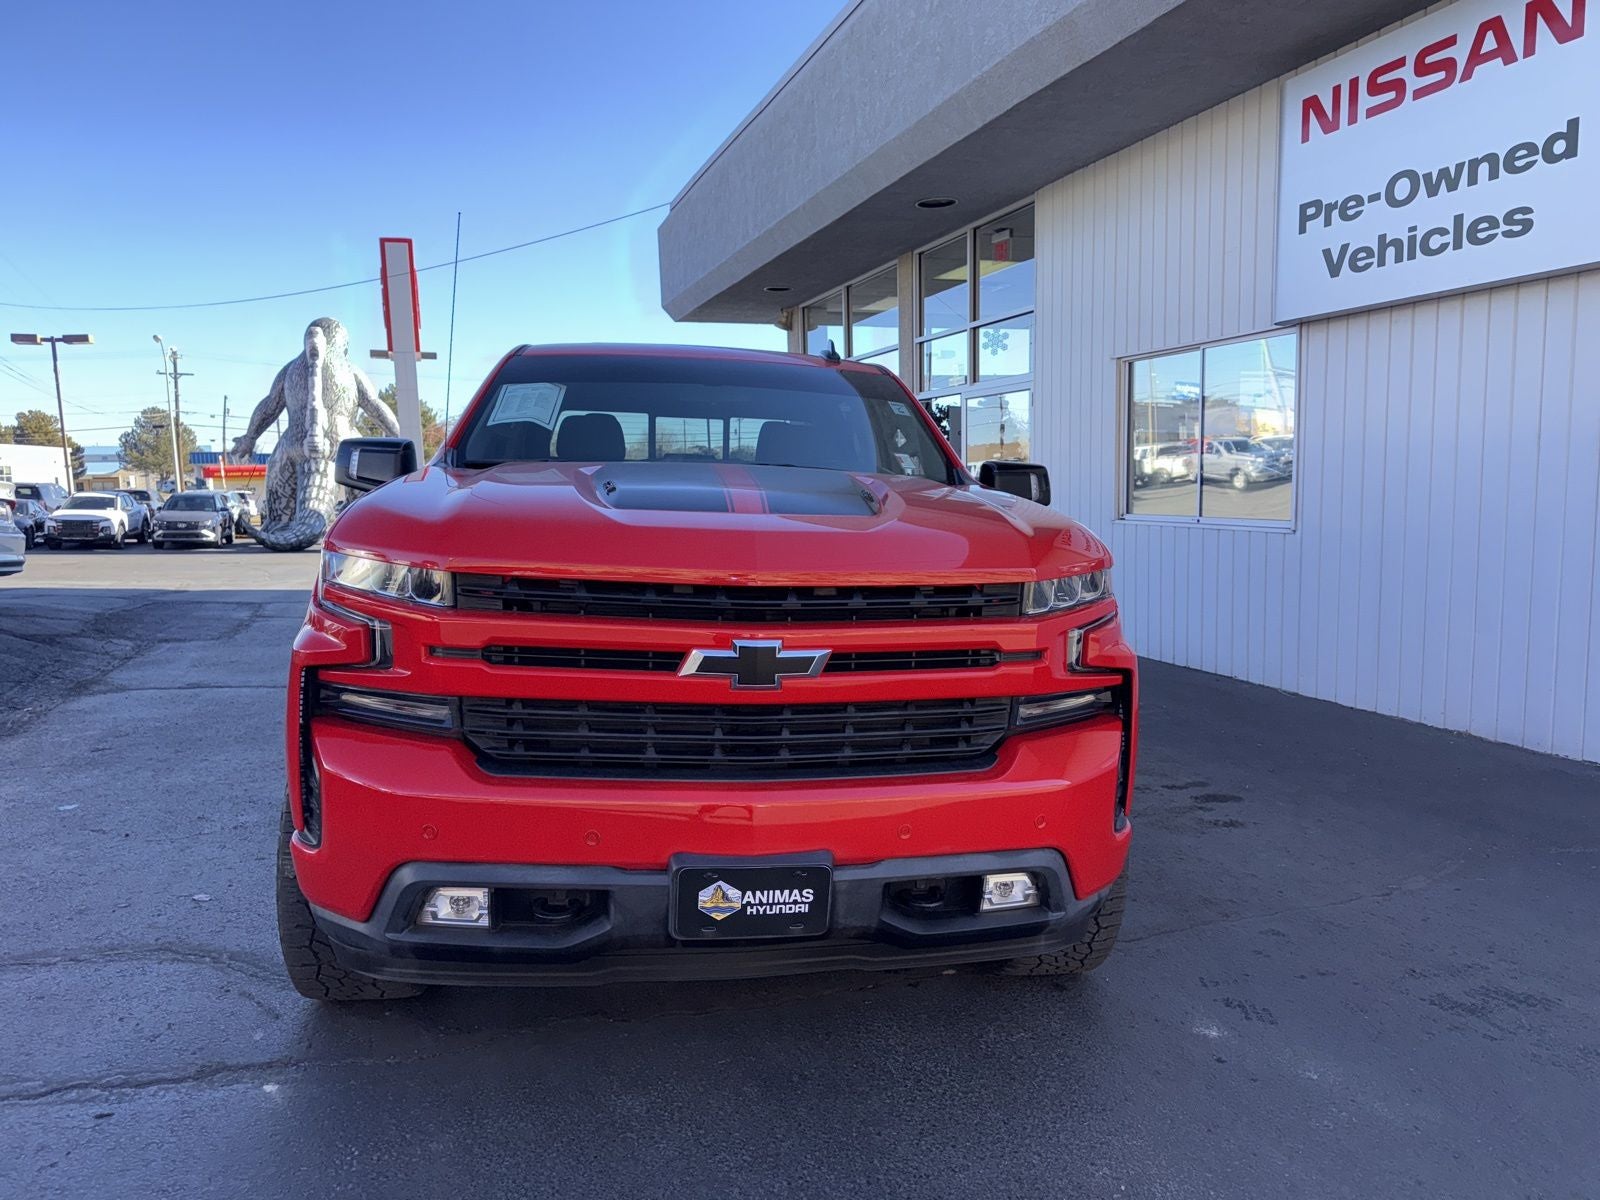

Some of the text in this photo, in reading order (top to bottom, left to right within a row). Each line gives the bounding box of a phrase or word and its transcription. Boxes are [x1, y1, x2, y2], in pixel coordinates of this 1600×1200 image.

[1301, 0, 1586, 144] NISSAN
[1298, 116, 1580, 235] Pre-Owned
[1321, 205, 1534, 278] Vehicles
[742, 888, 814, 905] ANIMAS
[746, 903, 809, 915] HYUNDAI
